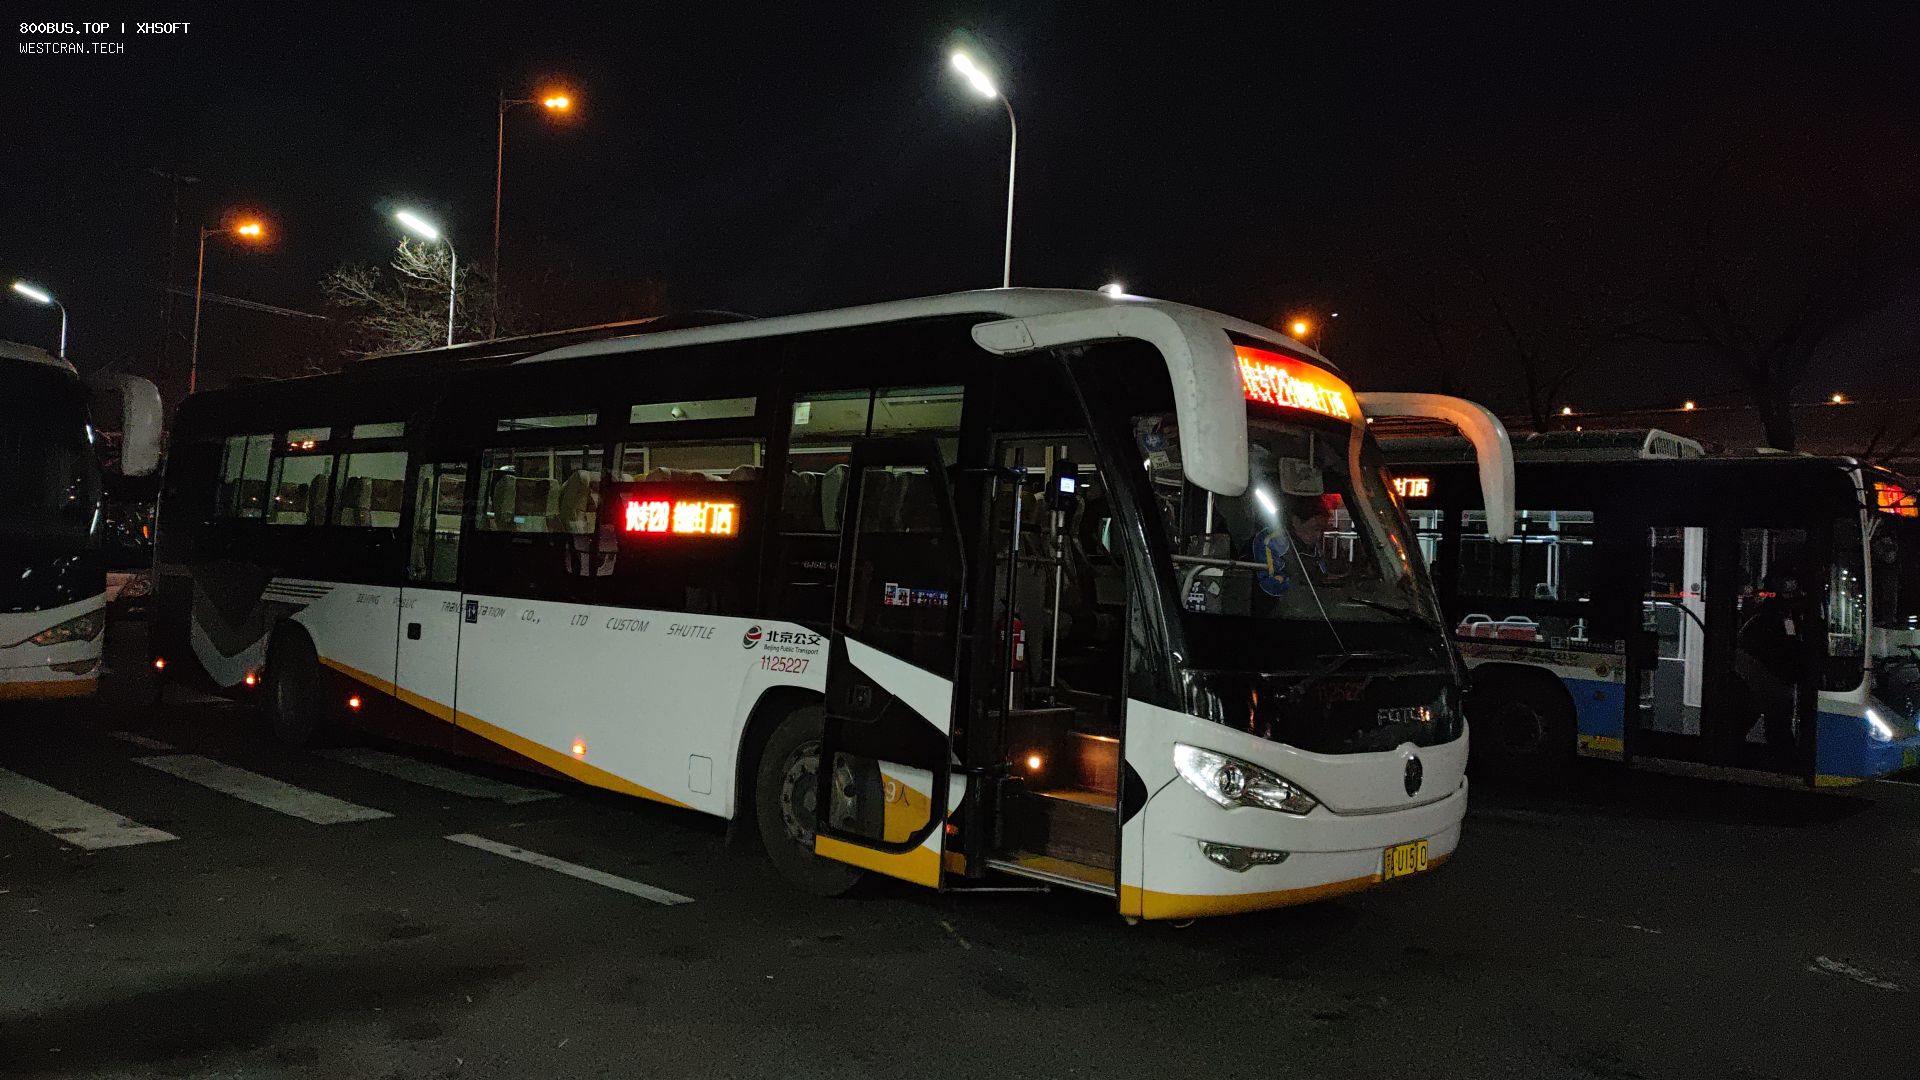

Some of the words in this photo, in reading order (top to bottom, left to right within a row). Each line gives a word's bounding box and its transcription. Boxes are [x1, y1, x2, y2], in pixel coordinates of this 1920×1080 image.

[570, 613, 590, 627] LTD
[606, 617, 650, 633] CUSTOM
[667, 623, 716, 640] SHUTTLE
[765, 629, 822, 646] 北京公交
[761, 654, 810, 675] 1125227
